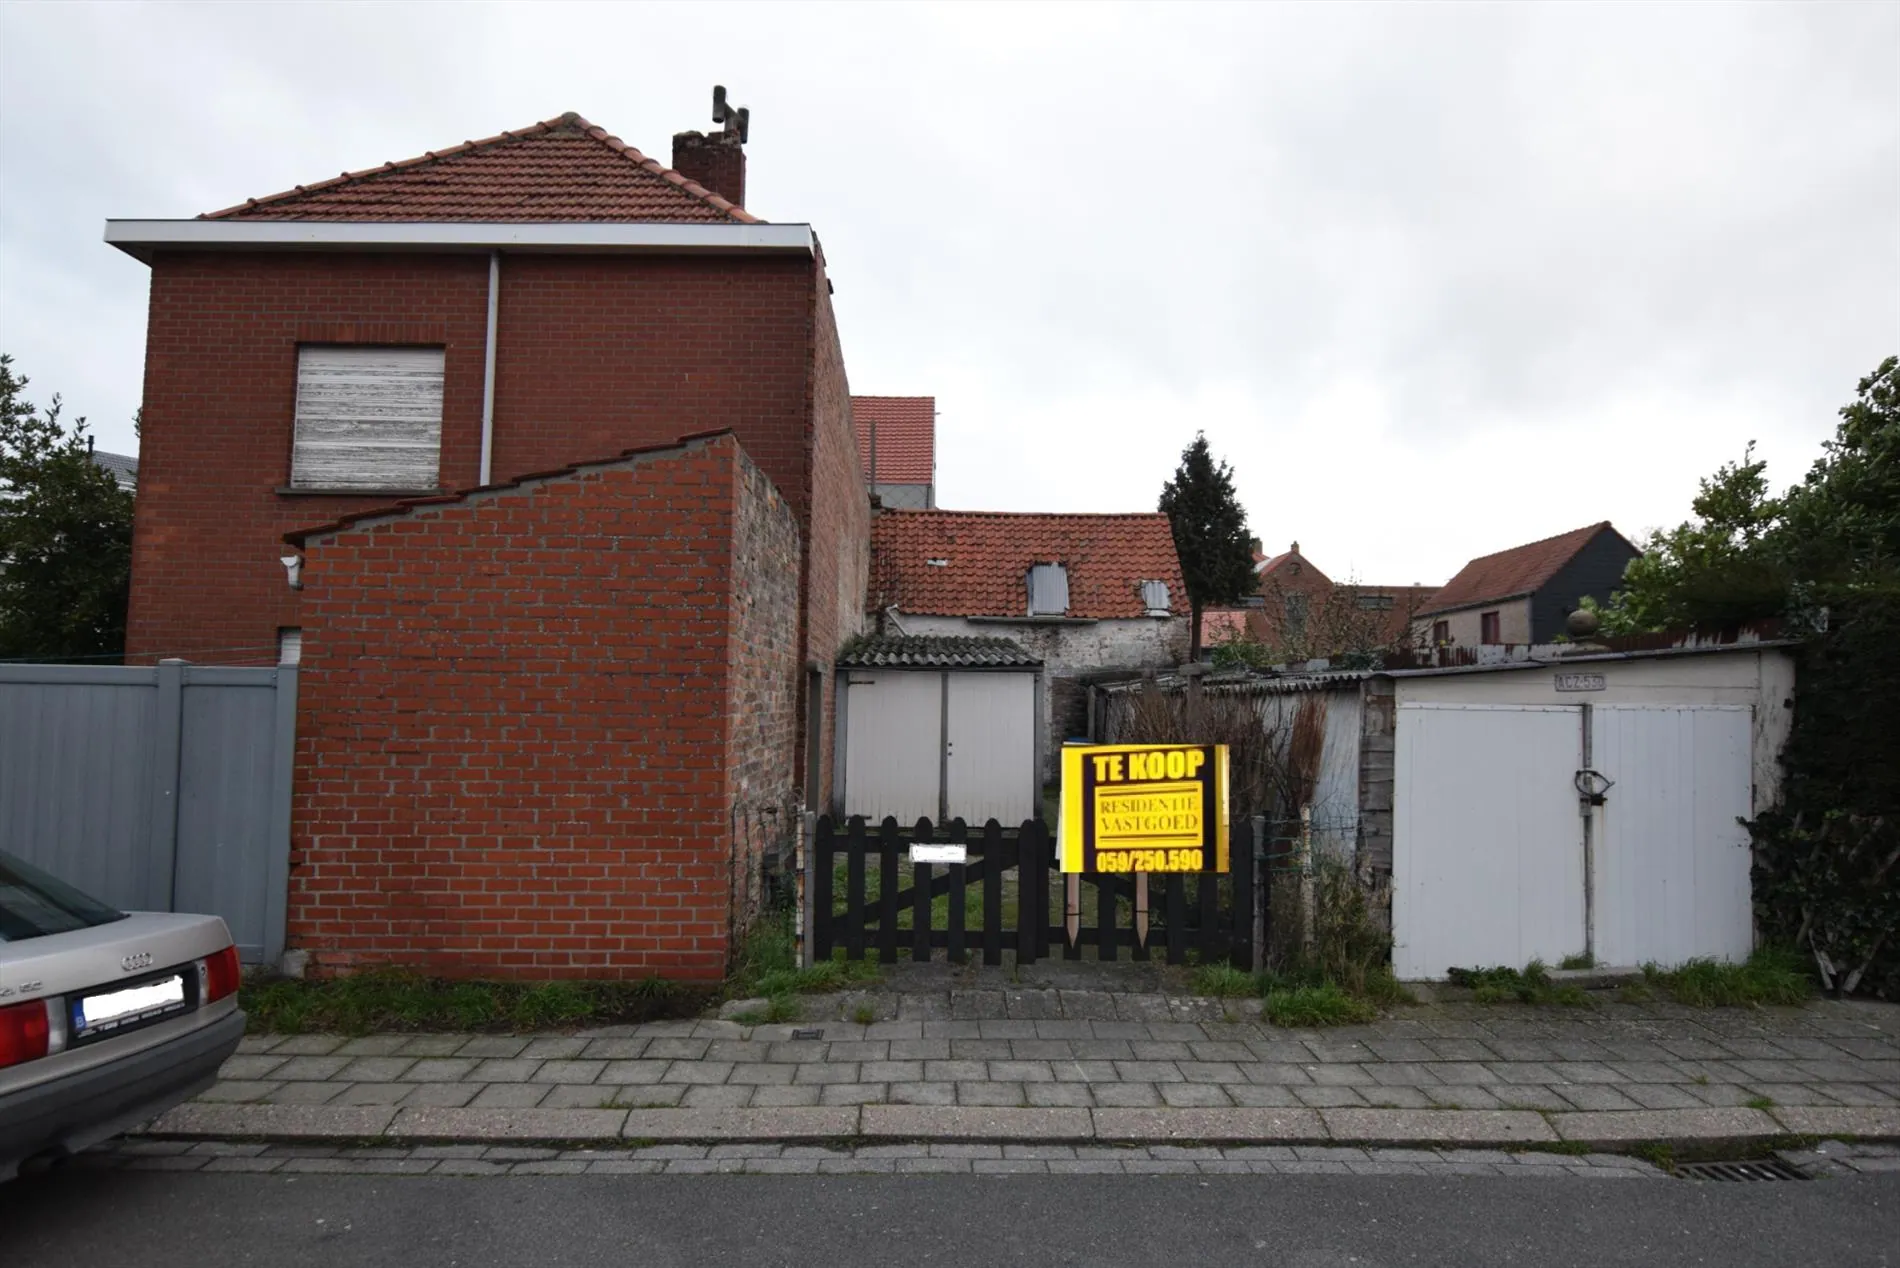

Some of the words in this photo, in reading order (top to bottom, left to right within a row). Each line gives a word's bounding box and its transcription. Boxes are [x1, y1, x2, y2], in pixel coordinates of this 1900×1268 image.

[1093, 755, 1123, 782] TE
[1129, 750, 1205, 780] KOOP
[1100, 797, 1198, 814] RESIDENTIE
[1101, 814, 1198, 832] VASTGOED
[1096, 849, 1203, 872] 059/250.590
